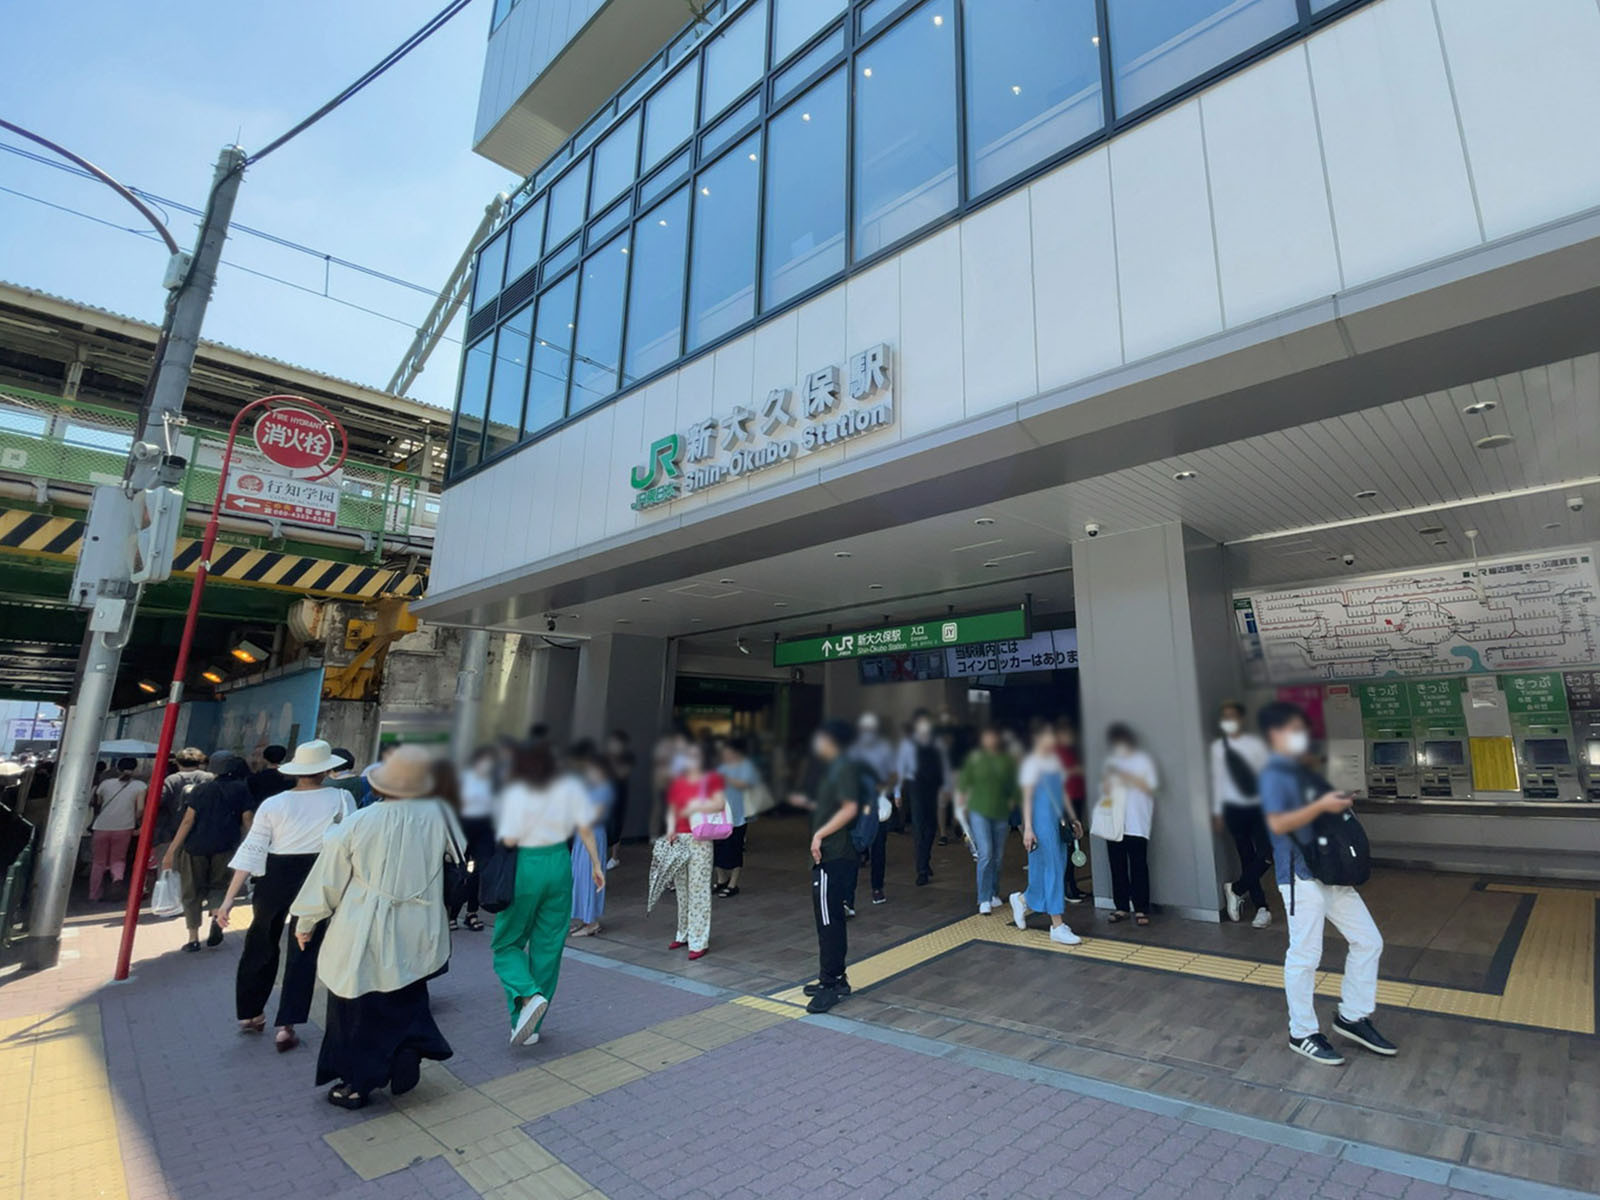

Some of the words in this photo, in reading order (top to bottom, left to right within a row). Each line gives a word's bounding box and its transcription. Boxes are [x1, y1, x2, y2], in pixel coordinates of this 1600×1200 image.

[686, 343, 890, 464] 新大久保駅
[271, 412, 289, 422] FIRE
[290, 417, 322, 430] HYDRANT
[262, 421, 328, 457] 消火栓
[685, 441, 795, 492] Shin-Okubo
[801, 404, 889, 450] Station
[630, 433, 680, 490] JR
[267, 480, 335, 503] 行知学园
[857, 629, 901, 646] 新大久保駅
[910, 625, 925, 636] 入口
[835, 635, 854, 651] JR
[957, 649, 1078, 673] コインロッカーはありま
[1367, 684, 1399, 697] きっぷ
[1416, 681, 1450, 694] きっぷ
[1513, 675, 1552, 689] きっぷ
